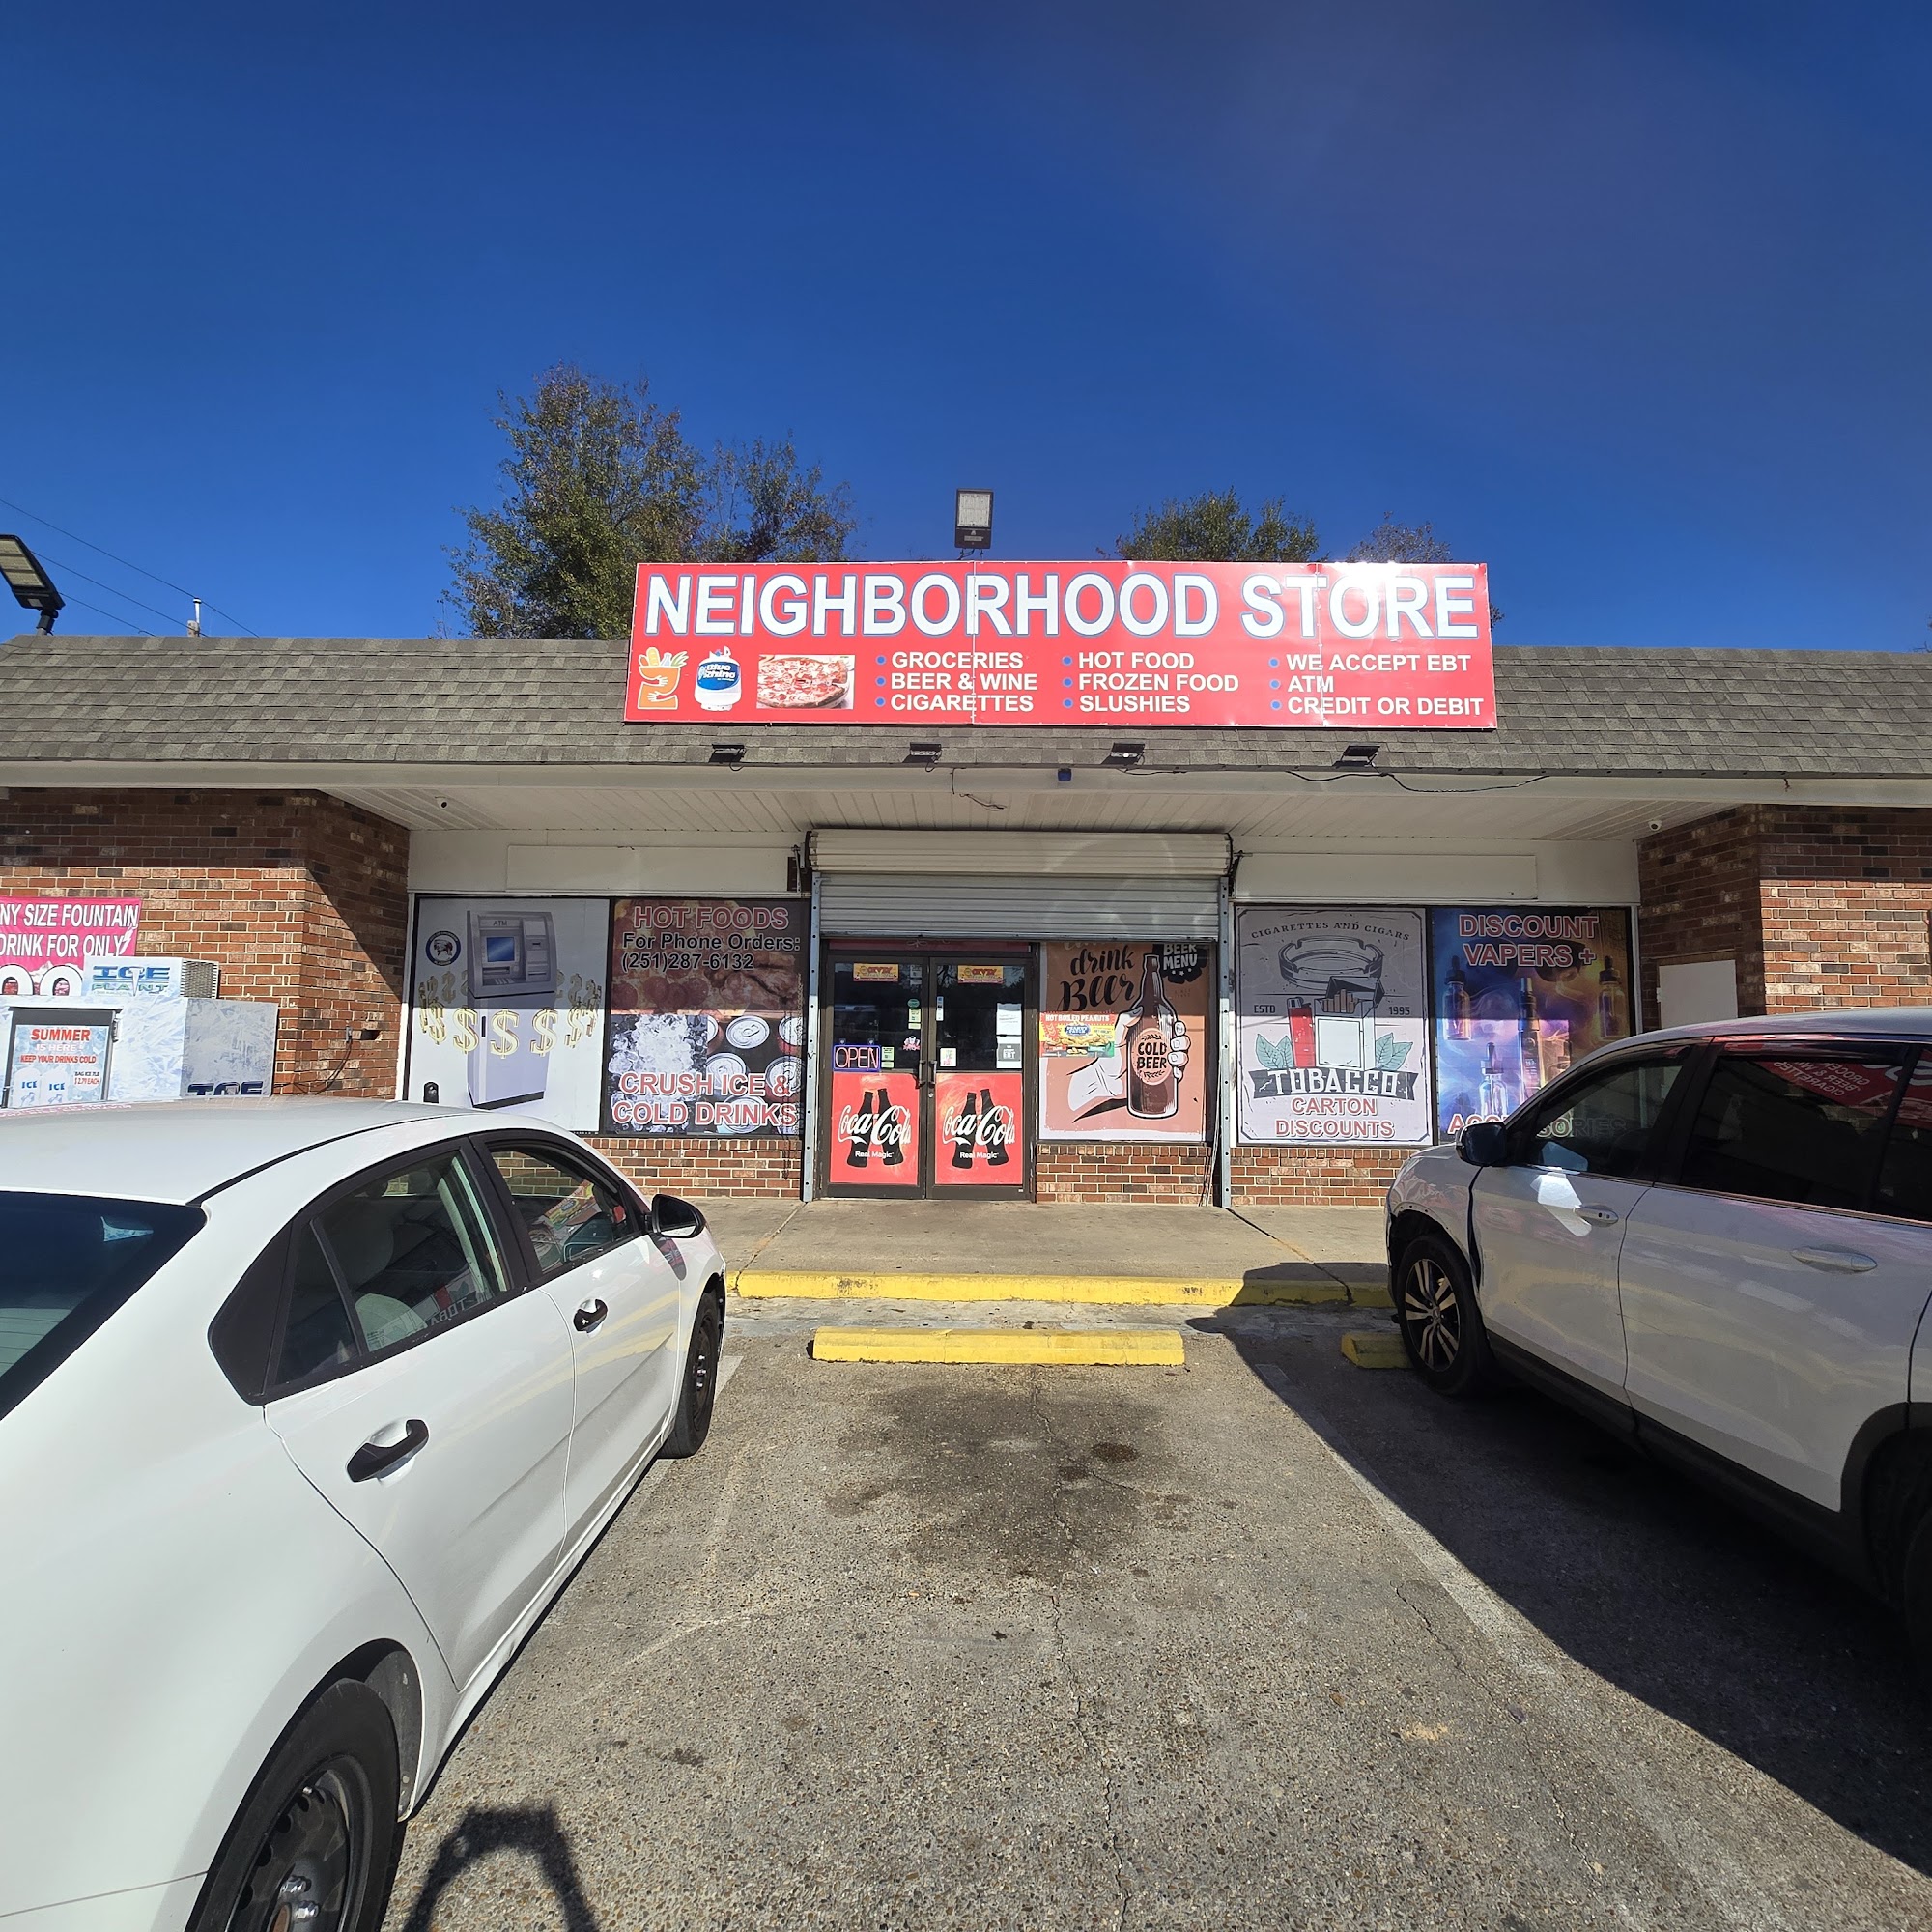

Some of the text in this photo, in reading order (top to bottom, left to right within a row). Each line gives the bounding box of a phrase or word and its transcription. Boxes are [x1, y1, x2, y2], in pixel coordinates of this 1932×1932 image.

[644, 572, 1479, 639] NEIGHBORHOOD STORE
[891, 652, 1024, 669] GROCERIES
[1078, 652, 1195, 670] HOT FOOD
[1286, 654, 1472, 672] WE ACCEPT EBT
[891, 672, 1038, 692] BEER & WINE
[1079, 672, 1239, 692] FROZEN FOOD
[1287, 675, 1335, 694] ATM
[891, 694, 1035, 713] CIGARETTES
[1079, 695, 1191, 713] SLUSHIES
[1288, 696, 1484, 716] CREDIT OR DEBIT
[23, 904, 58, 927] SIZE
[61, 904, 139, 927] FOUNTAIN
[633, 906, 789, 930] HOT FOODS
[1250, 921, 1411, 942] CIGARETTES AND CIGARS
[1459, 915, 1599, 939] DISCOUNT
[0, 934, 123, 957] DRINK FOR ONLY
[622, 932, 802, 952] For Phone Orders:
[1163, 944, 1198, 956] BEER
[621, 952, 754, 971] (251)287-6132
[1069, 945, 1135, 976] drink
[1163, 953, 1198, 971] MENU
[1462, 943, 1573, 967] VAPERS
[92, 966, 171, 980] ICE
[1057, 973, 1136, 1011] Beer
[1253, 1004, 1276, 1014] ESTD
[1388, 1006, 1411, 1016] 1995
[31, 1028, 91, 1041] SUMMER
[835, 1047, 879, 1069] OPEN
[1137, 1042, 1168, 1057] COLD
[79, 1056, 97, 1065] COLD
[1136, 1056, 1168, 1070] BEER
[21, 1080, 38, 1089] ICE
[48, 1082, 66, 1091] ICE
[619, 1072, 791, 1097] CRUSH ICE &
[1267, 1067, 1401, 1096] TOBACCO
[611, 1102, 798, 1127] COLD DRINKS
[1291, 1096, 1378, 1117] CARTON
[838, 1104, 911, 1145] Coca-Cola
[942, 1104, 1015, 1146] Coca-Cola
[1274, 1119, 1397, 1139] DISCOUNTS
